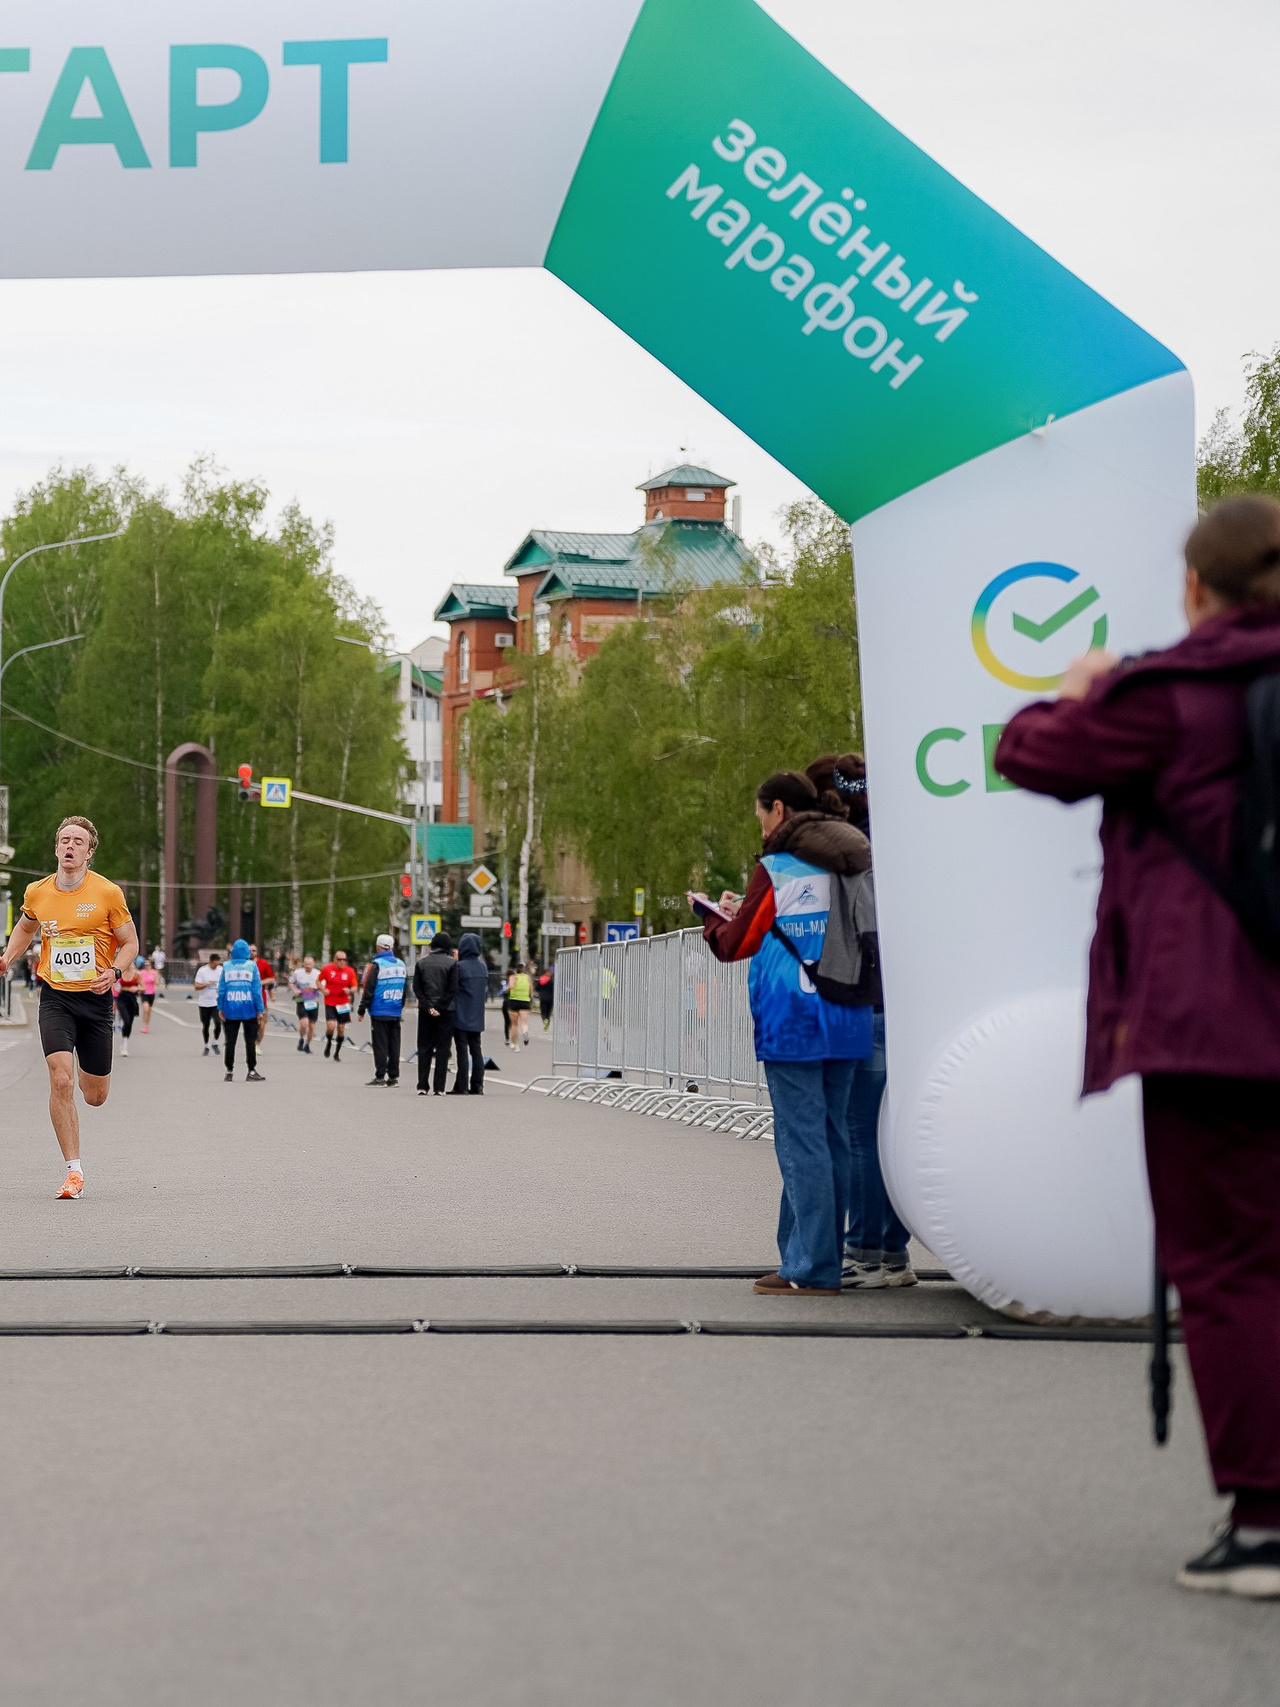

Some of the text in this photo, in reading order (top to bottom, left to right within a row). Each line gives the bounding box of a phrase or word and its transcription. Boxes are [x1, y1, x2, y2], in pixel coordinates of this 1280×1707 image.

[666, 163, 924, 389] марафон
[711, 118, 979, 343] зелёный
[55, 951, 91, 966] 4003
